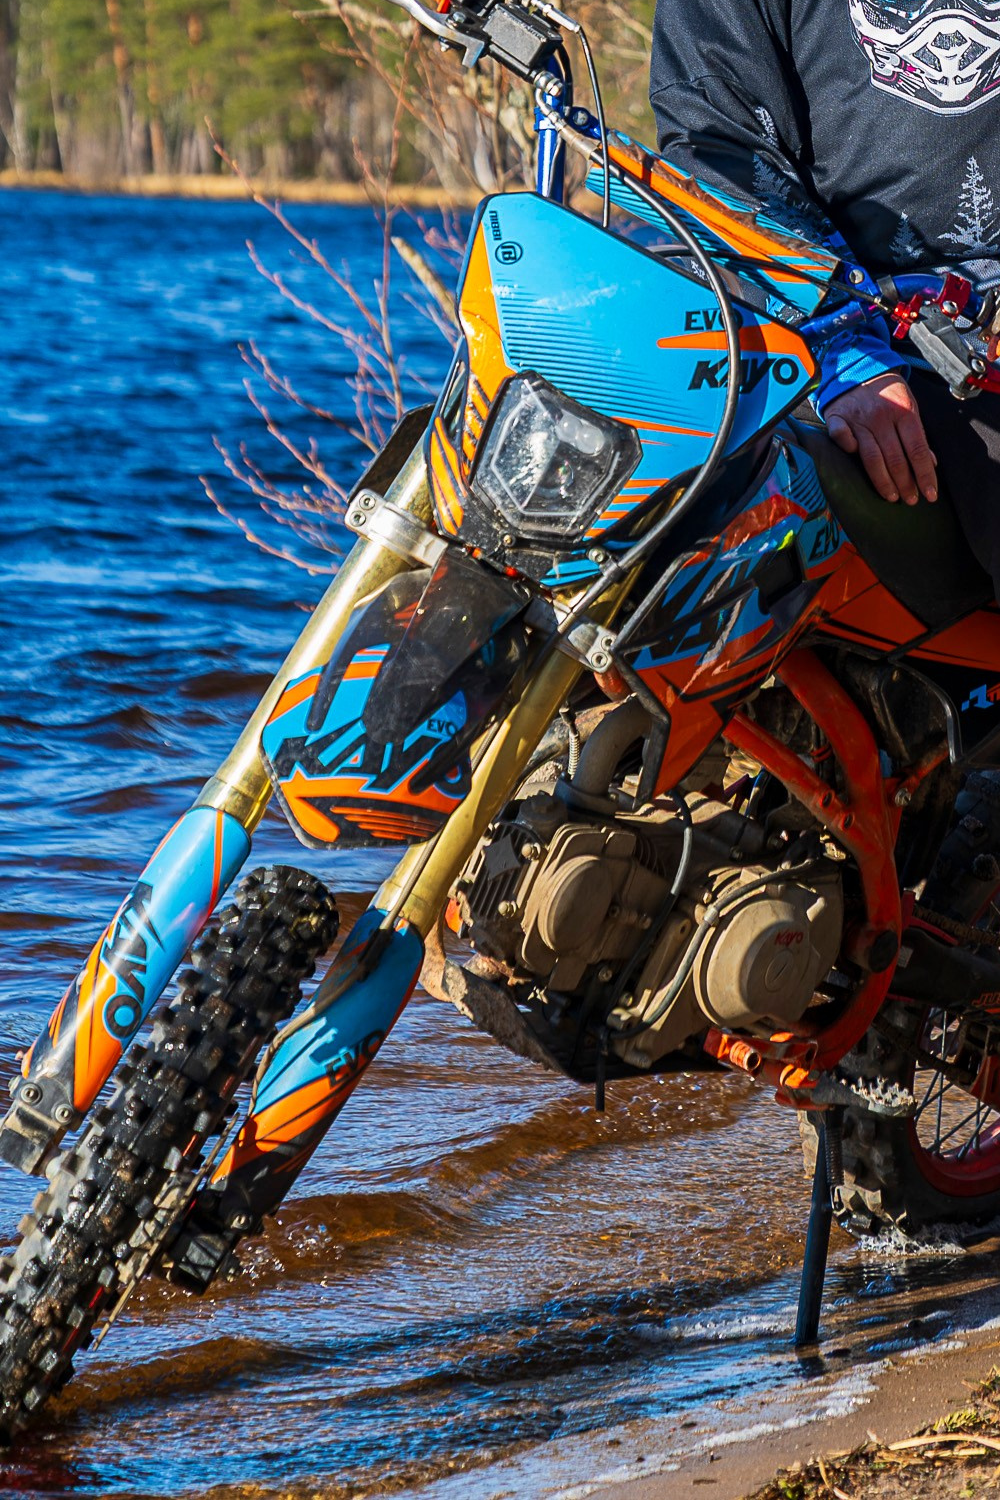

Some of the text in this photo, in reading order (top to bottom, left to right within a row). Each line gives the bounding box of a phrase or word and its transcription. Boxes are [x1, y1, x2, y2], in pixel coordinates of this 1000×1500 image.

[684, 307, 744, 332] EVO
[688, 355, 800, 395] KAYO
[809, 514, 840, 562] EVO
[426, 718, 459, 736] EVO
[325, 1030, 384, 1089] EVO
